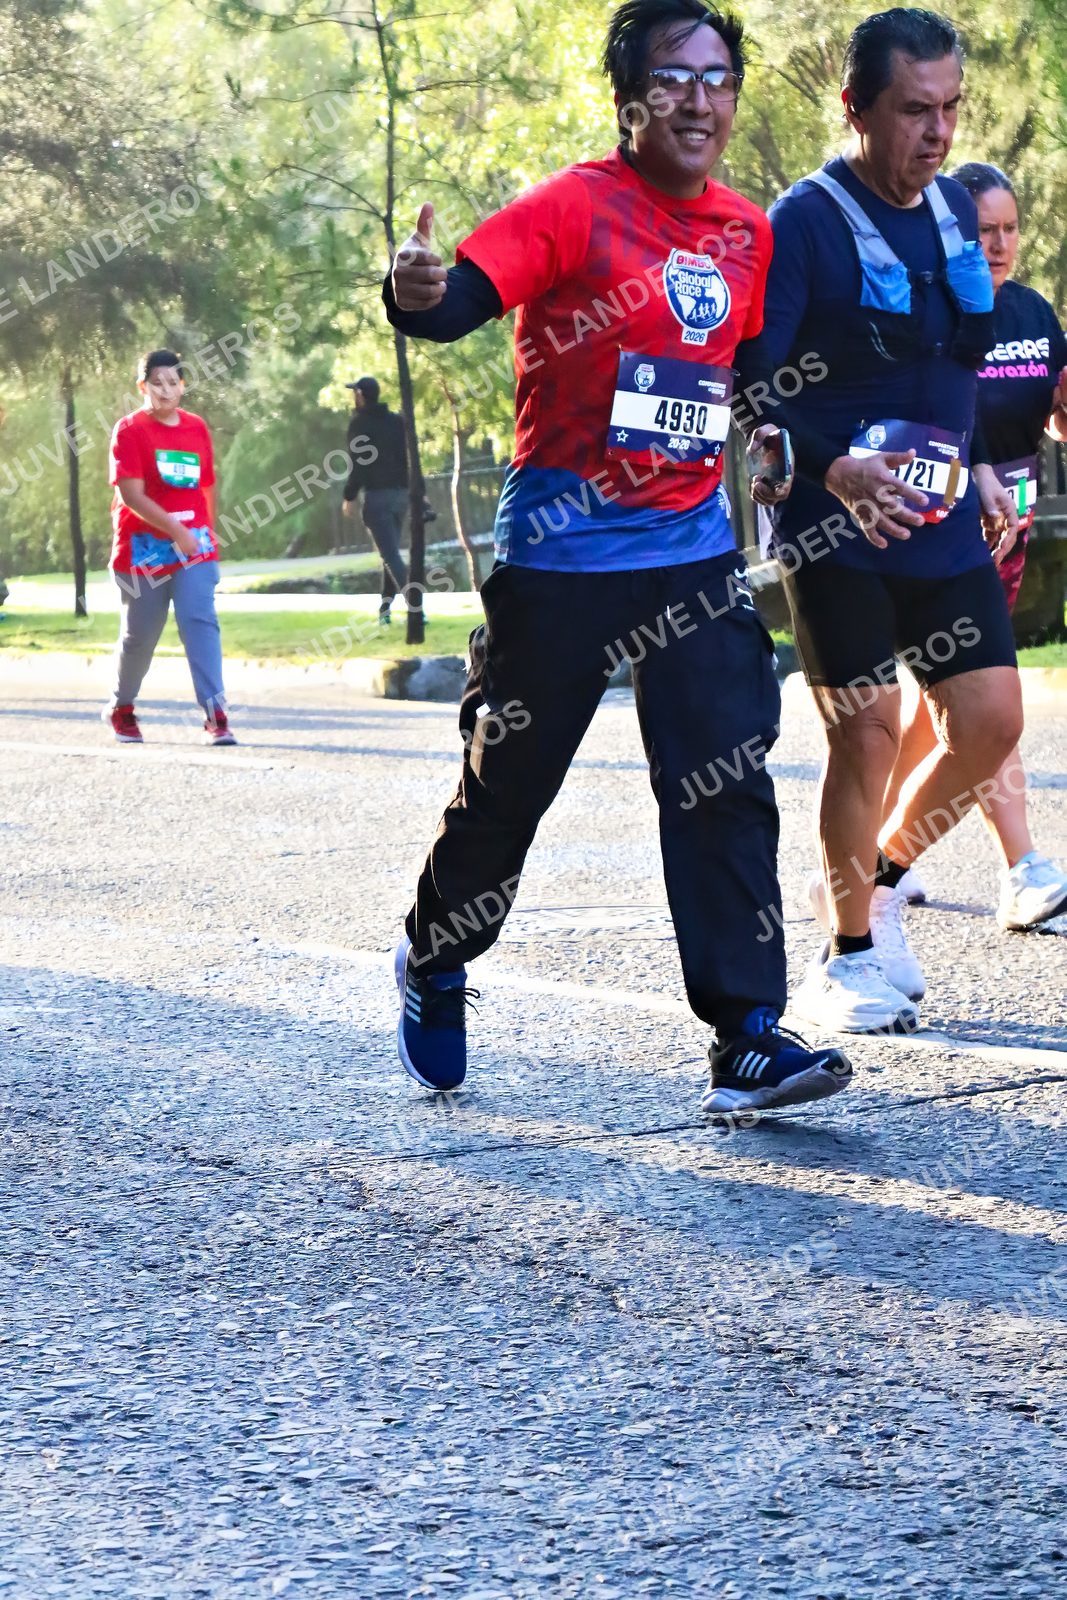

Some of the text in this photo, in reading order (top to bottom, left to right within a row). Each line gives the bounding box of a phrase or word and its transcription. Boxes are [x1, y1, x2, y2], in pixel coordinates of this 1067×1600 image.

[678, 271, 711, 288] Global
[674, 281, 701, 297] Race
[684, 331, 705, 342] 2026
[654, 400, 708, 435] 4930
